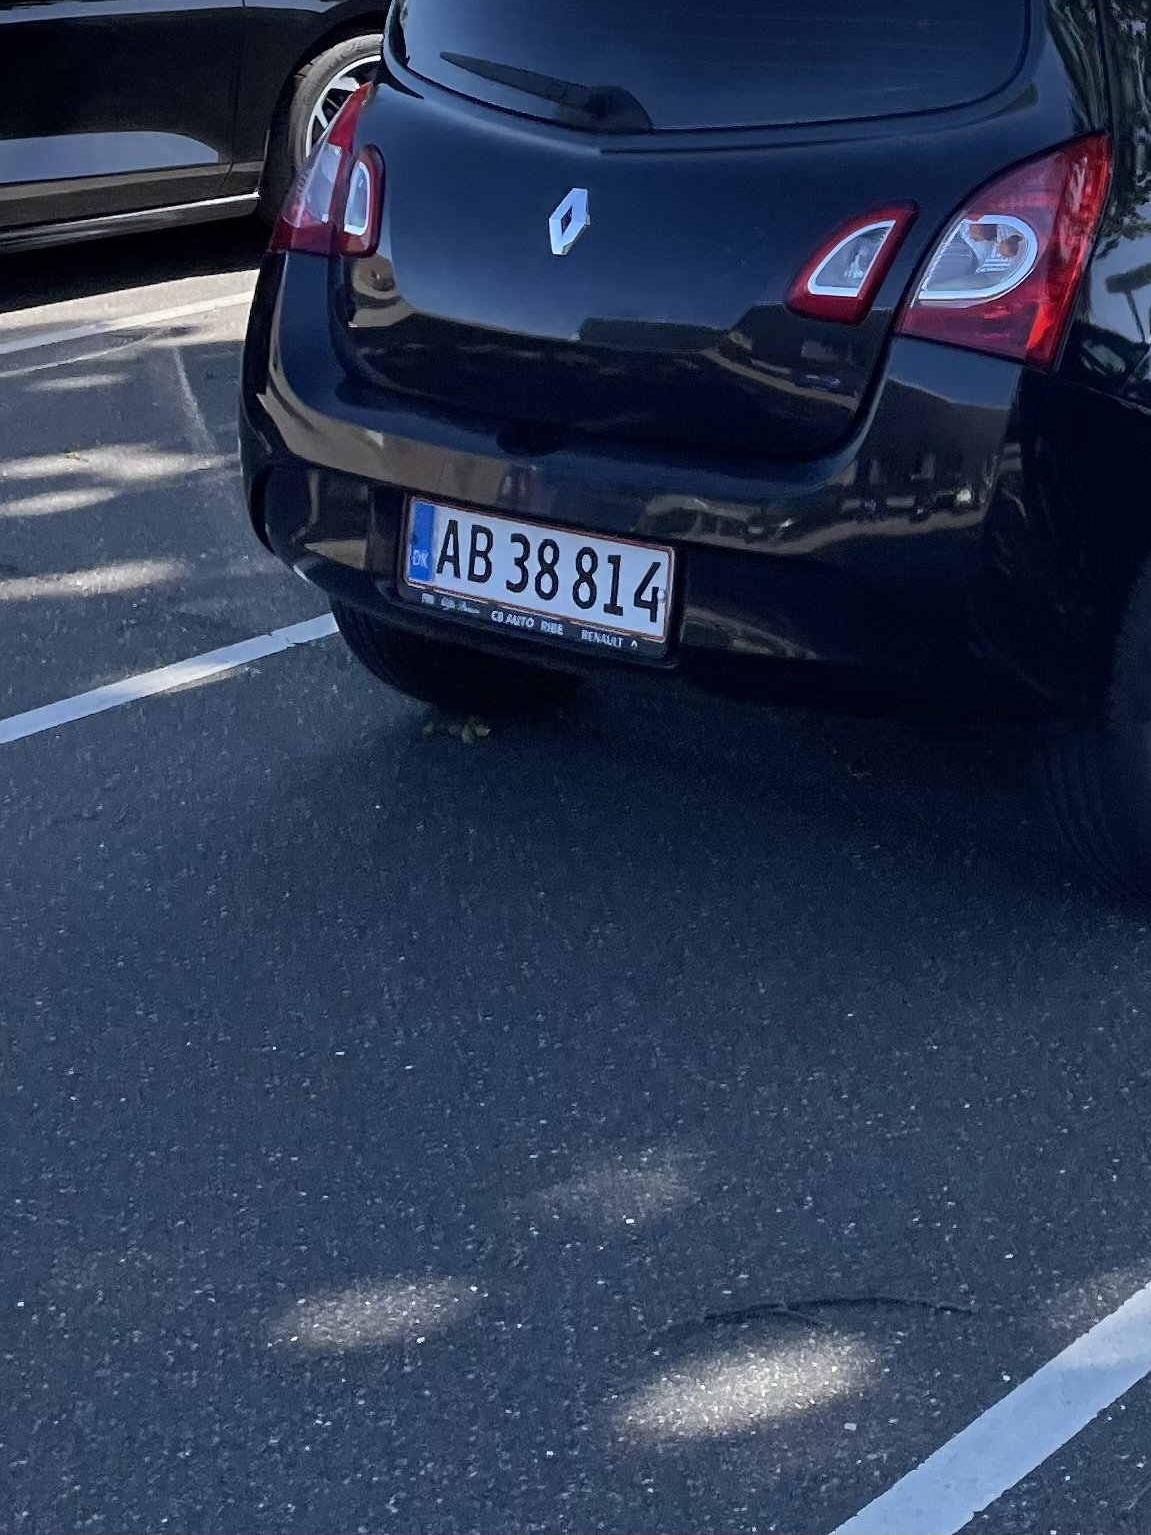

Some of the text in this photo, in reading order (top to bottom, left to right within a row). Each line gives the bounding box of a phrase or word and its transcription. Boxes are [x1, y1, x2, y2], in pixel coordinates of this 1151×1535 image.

[411, 549, 429, 569] DK
[436, 519, 661, 623] AB 38 814
[505, 613, 535, 628] AUTO
[581, 629, 623, 648] RENAULT
